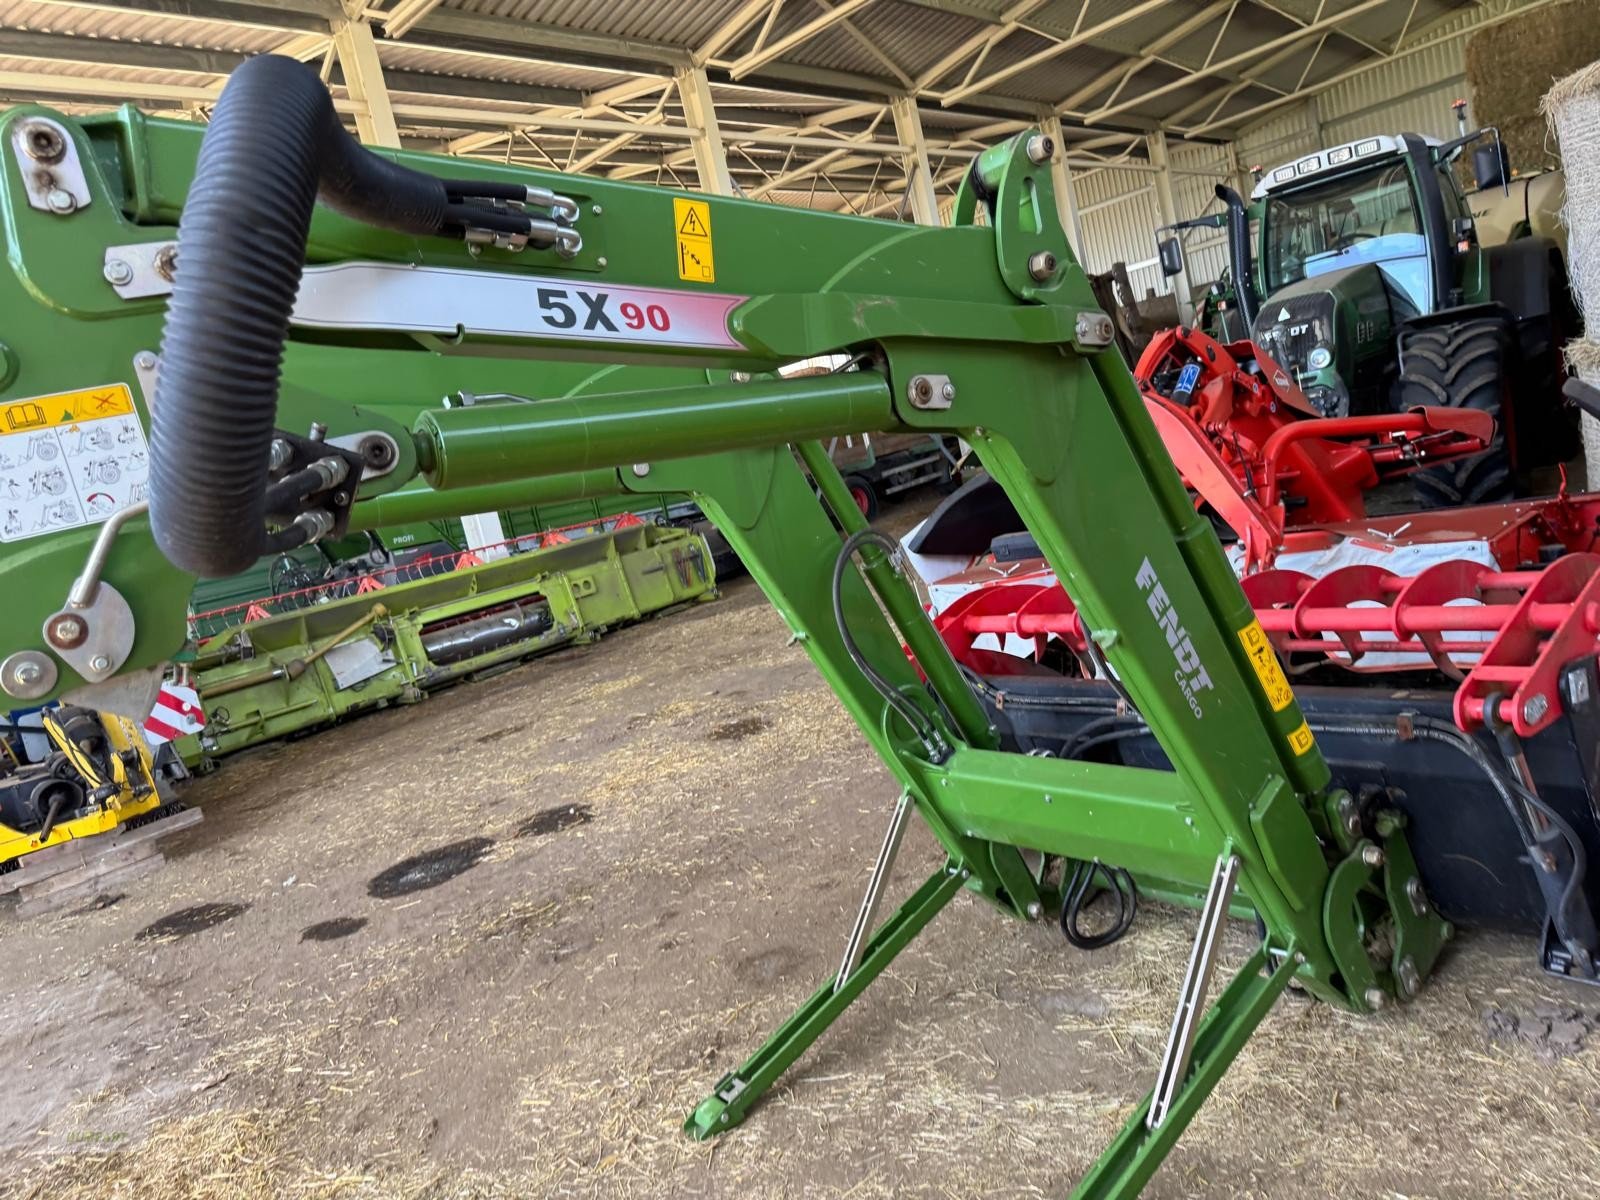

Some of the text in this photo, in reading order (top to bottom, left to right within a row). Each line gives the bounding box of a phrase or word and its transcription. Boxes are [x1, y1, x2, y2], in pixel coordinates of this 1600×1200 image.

[1264, 324, 1309, 342] FEDT
[393, 534, 415, 544] PROFI
[1135, 555, 1215, 693] FENDT
[1174, 669, 1203, 720] CARGO
